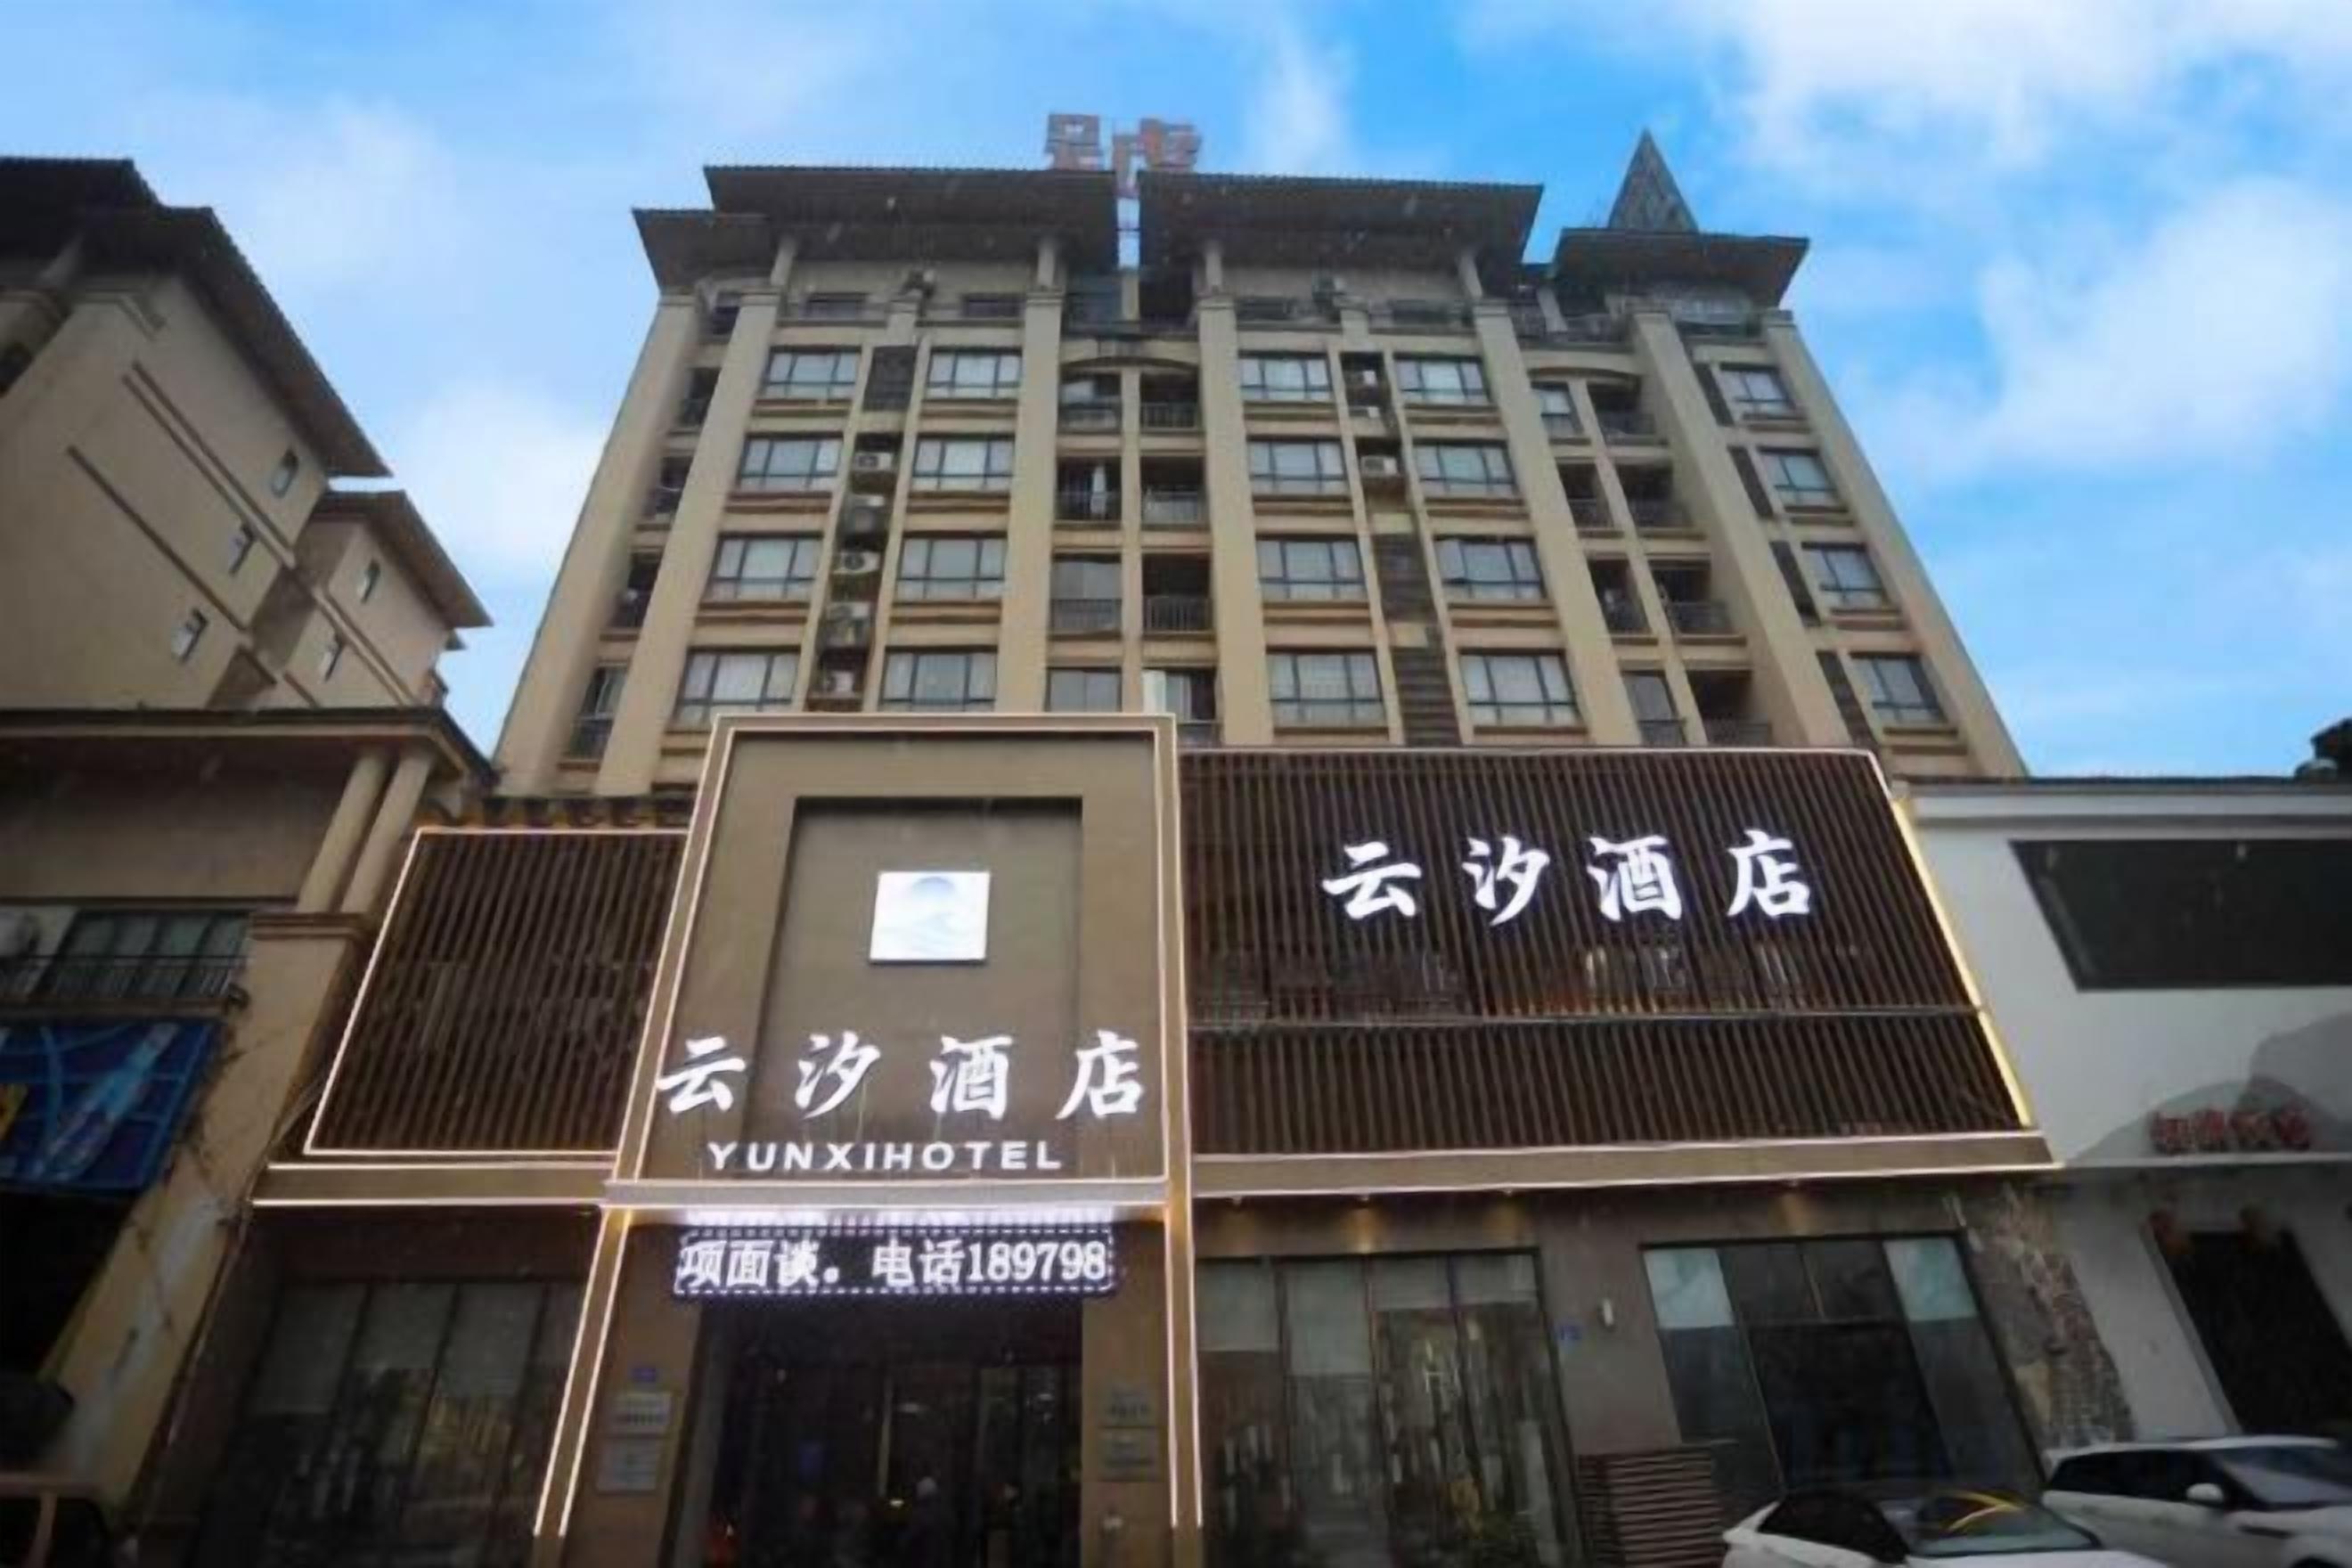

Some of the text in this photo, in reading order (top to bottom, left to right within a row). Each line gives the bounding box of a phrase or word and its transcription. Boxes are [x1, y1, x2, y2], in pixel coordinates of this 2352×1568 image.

[1322, 829, 1809, 925] 云汐酒店
[656, 1030, 1144, 1120] 云汐酒店
